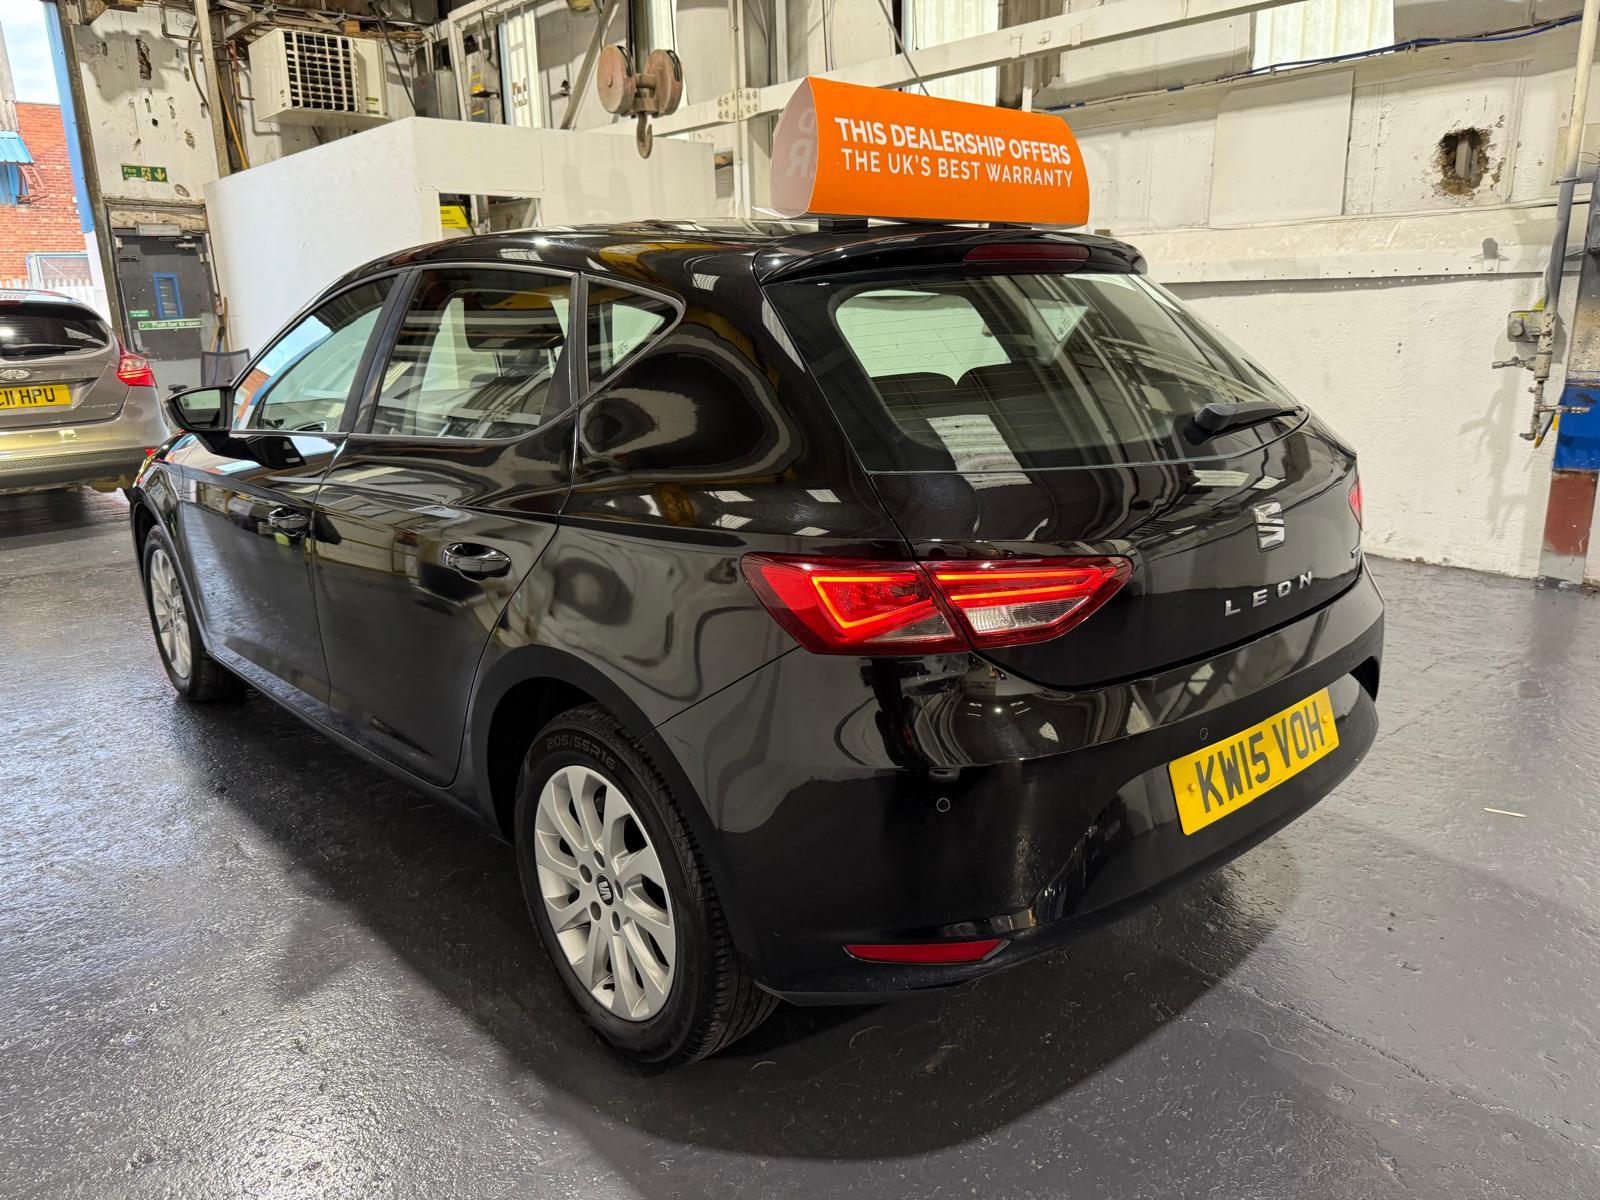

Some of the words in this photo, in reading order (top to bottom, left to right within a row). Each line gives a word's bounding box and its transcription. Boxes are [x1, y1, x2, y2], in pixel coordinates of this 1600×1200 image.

[833, 116, 888, 146] THIS
[889, 123, 1006, 158] DEALERSHIP
[1008, 138, 1071, 165] OFFERS
[840, 147, 881, 173] THE
[887, 152, 932, 177] UK'S
[937, 157, 981, 181] BEST
[985, 162, 1073, 188] WARRANTY
[19, 387, 56, 405] HPU
[1224, 570, 1313, 617] LEON
[546, 734, 616, 771] 205/55R16
[1195, 731, 1271, 814] KW15
[1271, 701, 1326, 769] VOH
